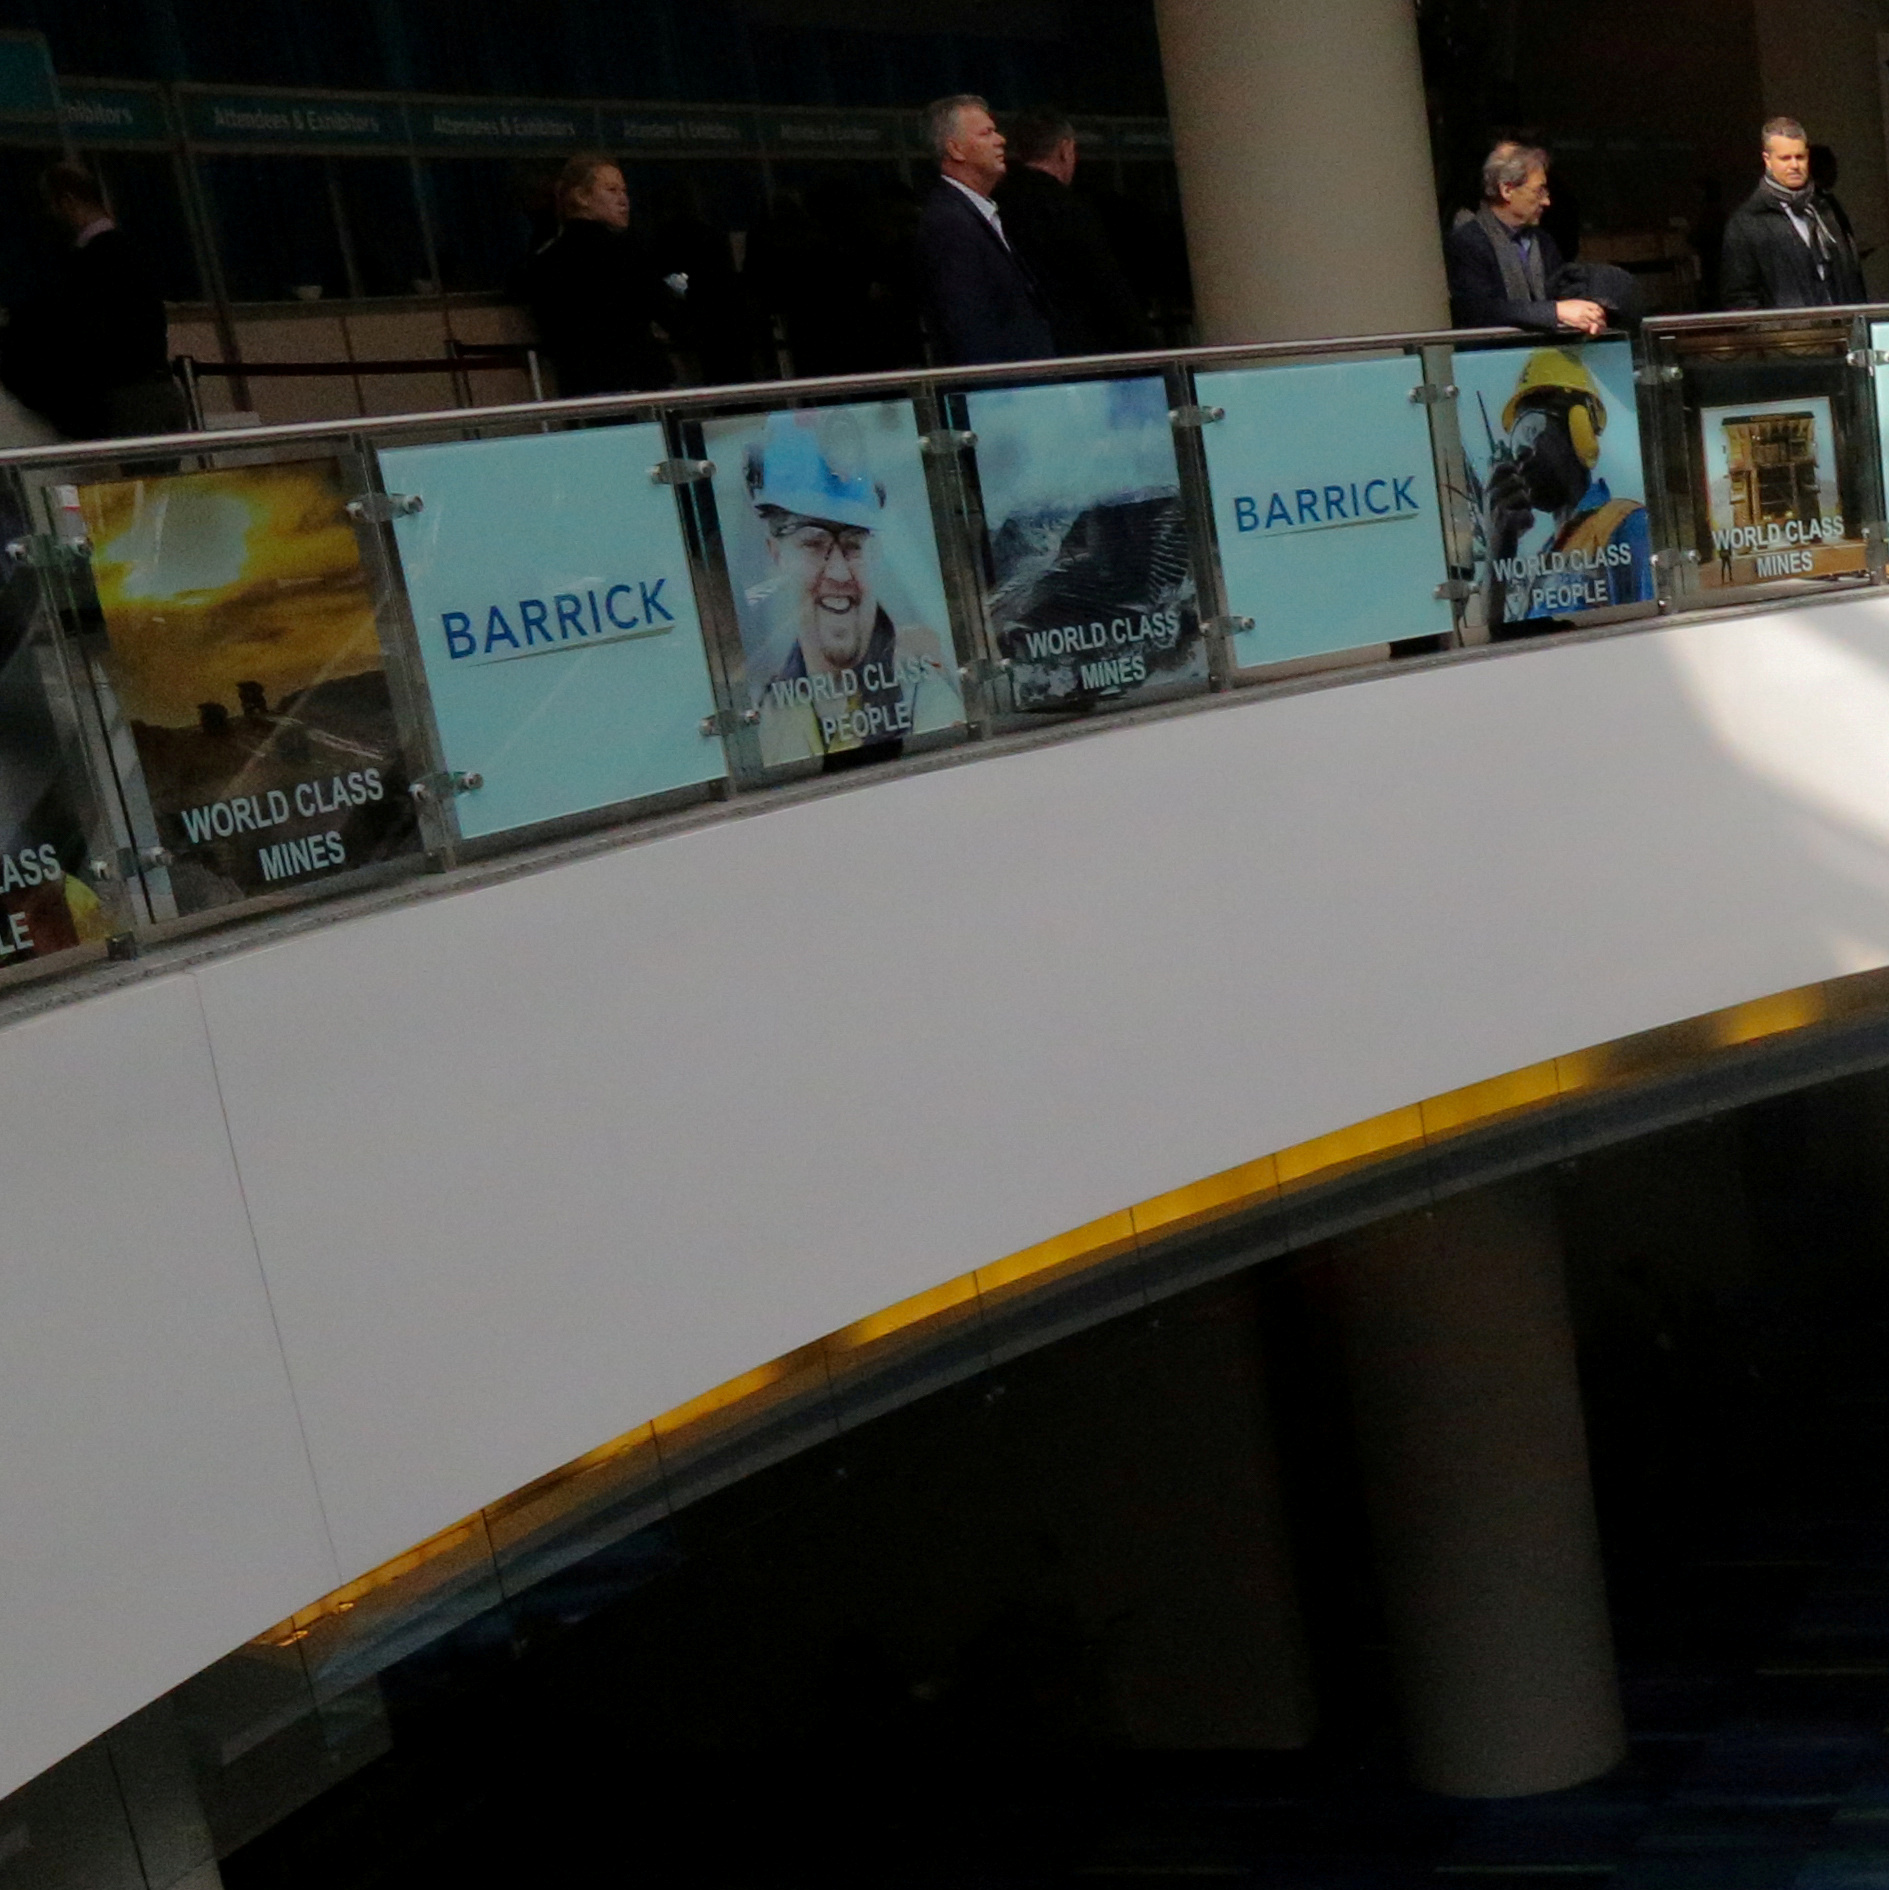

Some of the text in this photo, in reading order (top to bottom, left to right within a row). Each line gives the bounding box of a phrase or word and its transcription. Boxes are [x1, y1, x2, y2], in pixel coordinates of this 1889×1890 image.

[1234, 475, 1420, 532] BARRICK
[1713, 515, 1845, 550] WORLD CLASS
[1494, 543, 1631, 582] WORLD CLASS
[1757, 552, 1814, 578] MINES
[441, 578, 675, 659] BARRICK
[1533, 580, 1609, 610] PEOPLE
[1025, 611, 1180, 660] WORLD CLASS
[772, 654, 936, 708] WORLD CLASS
[1081, 656, 1147, 691] MINES
[823, 703, 911, 744] PEOPLE
[181, 767, 384, 844] WORLD CLASS
[0, 843, 60, 894] ASS
[258, 831, 346, 882] MINES
